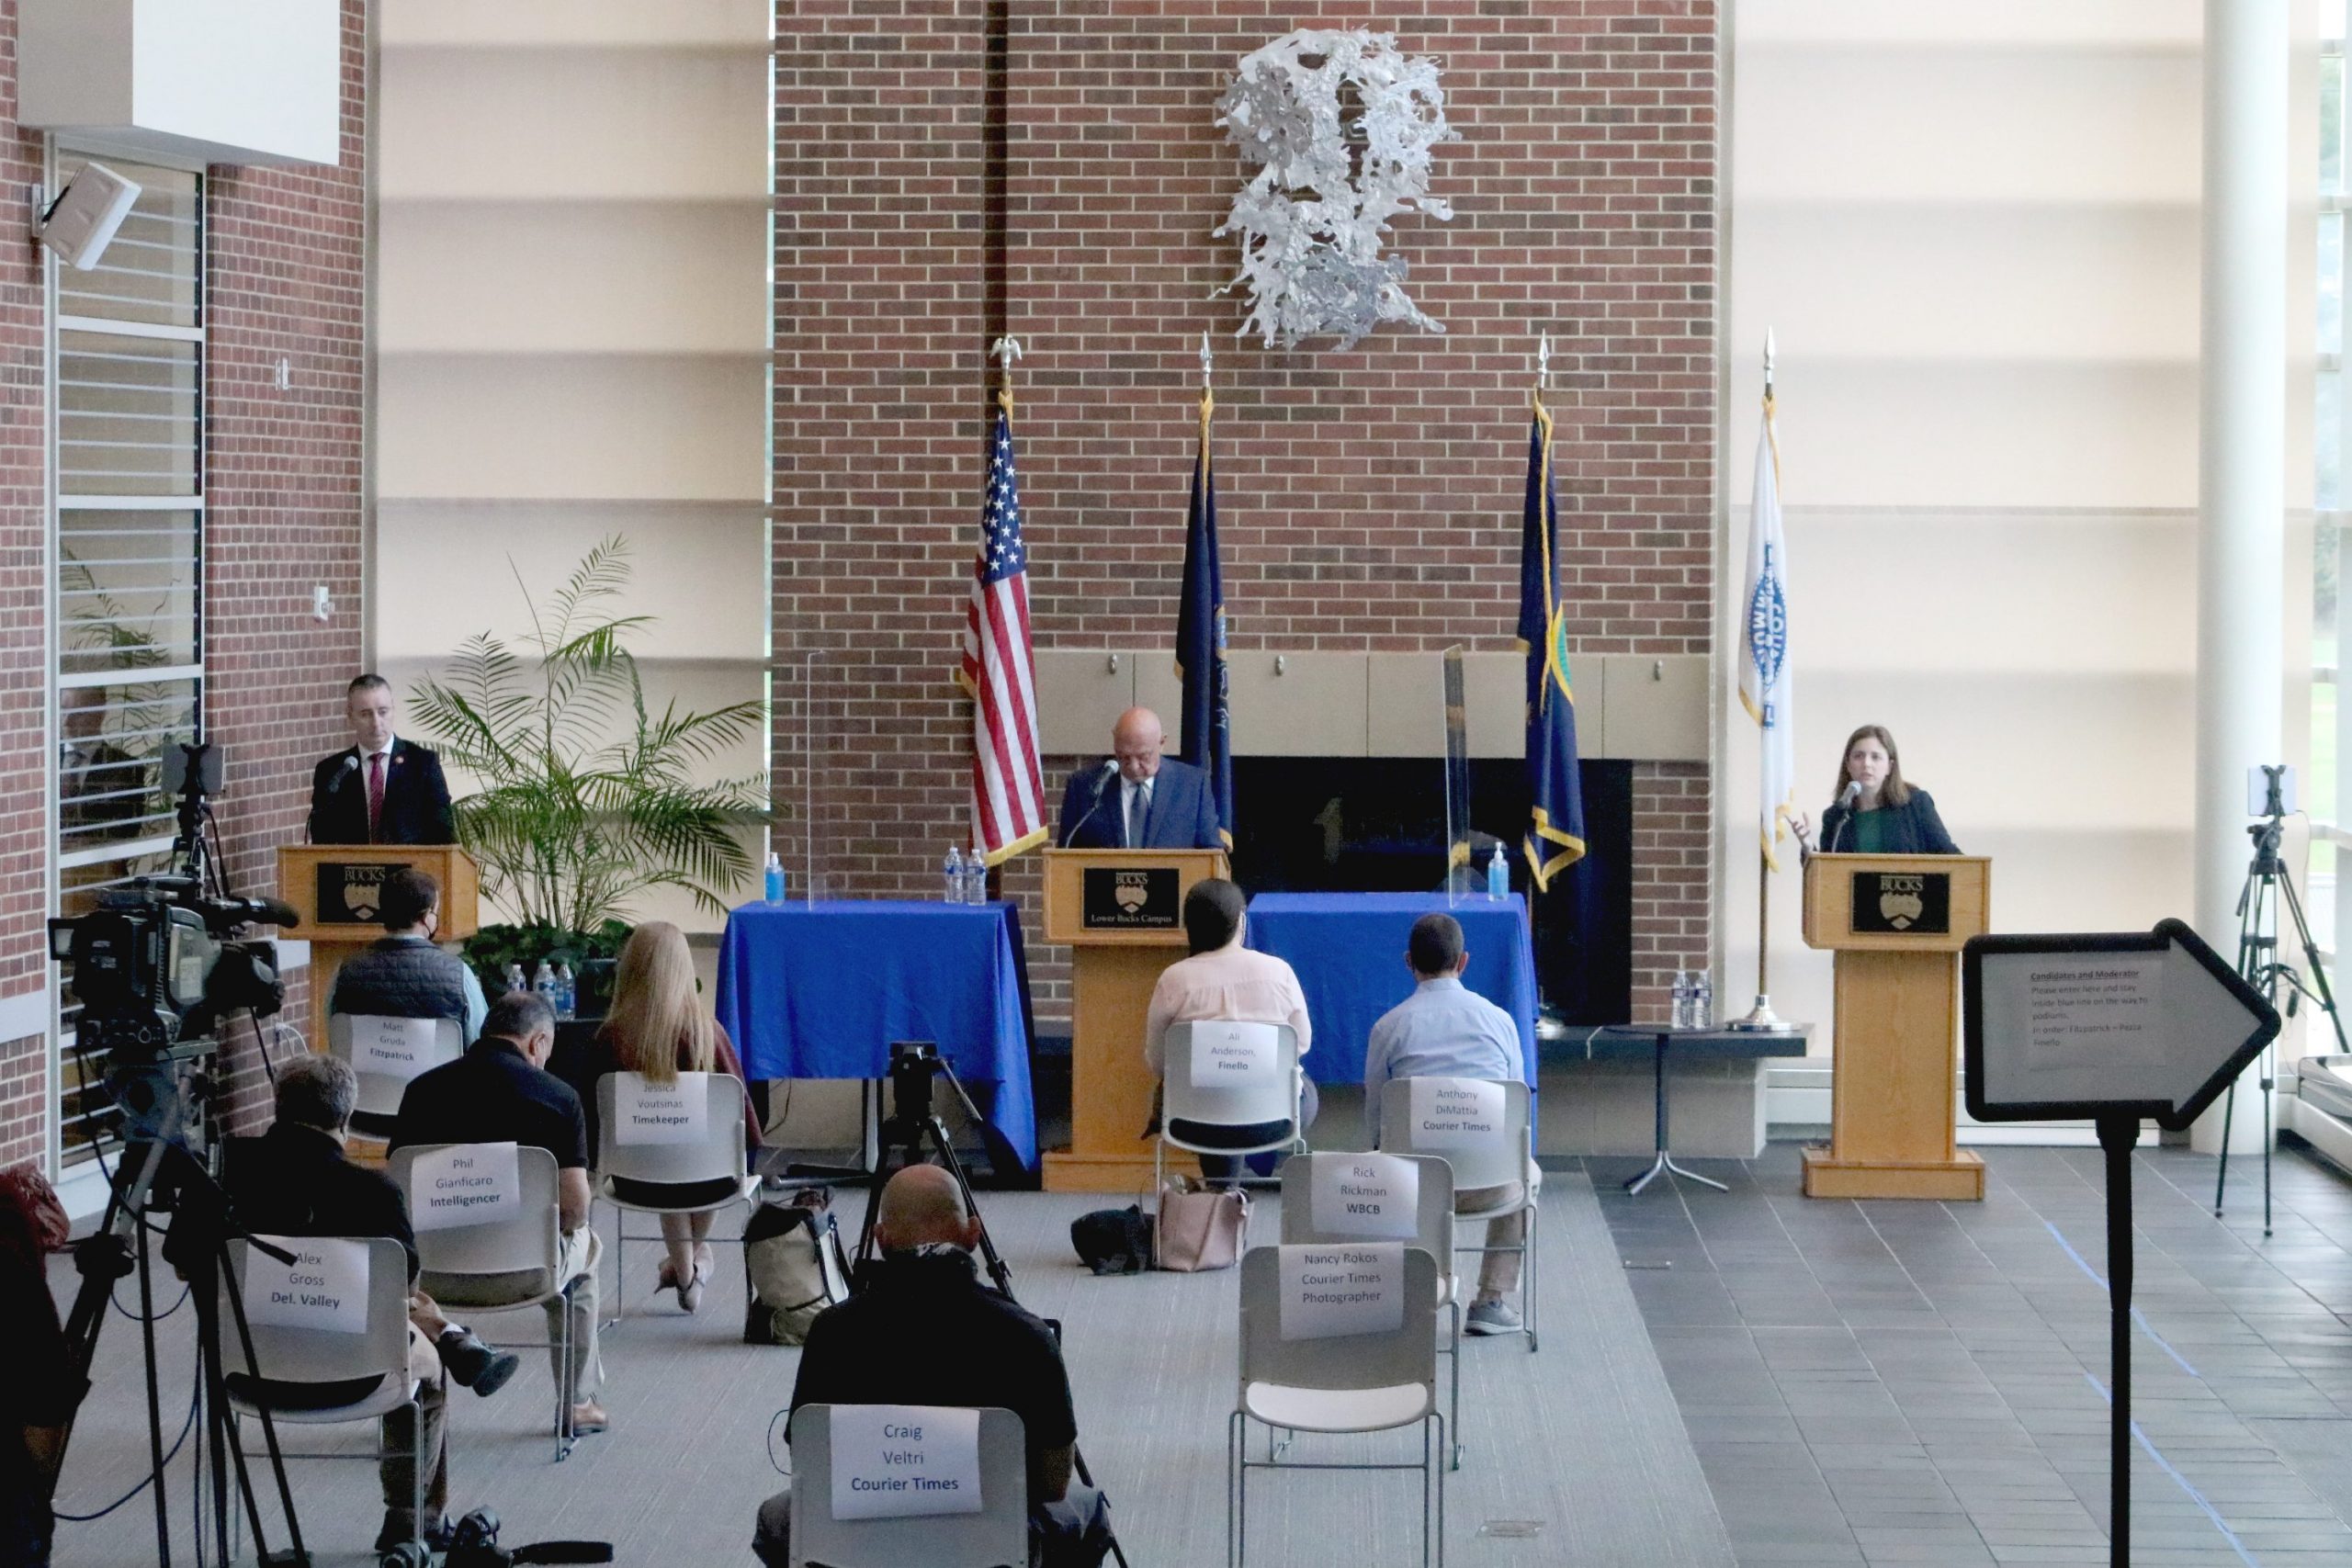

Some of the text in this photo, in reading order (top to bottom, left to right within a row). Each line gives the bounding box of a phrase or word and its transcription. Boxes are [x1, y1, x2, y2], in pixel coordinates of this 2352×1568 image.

[345, 867, 387, 882] BUCKS
[1115, 874, 1148, 885] BUCKS
[1880, 877, 1924, 892] BUCKS
[1091, 914, 1173, 924] Lower Bucks Campus
[2030, 969, 2140, 981] Candidates and Moderator
[2031, 987, 2057, 995] Please
[383, 1022, 403, 1032] Matt
[379, 1035, 406, 1046] Gruda
[1227, 1032, 1240, 1042] Ali
[369, 1047, 414, 1062] Fitzpatrick
[1211, 1046, 1256, 1057] Anderson,
[1218, 1061, 1249, 1070] Finello
[1436, 1089, 1478, 1100] Anthony
[637, 1100, 684, 1110] Voutsinas
[1436, 1105, 1478, 1115] DiMattia
[632, 1115, 689, 1126] Timekeeper
[1423, 1121, 1491, 1132] Courier Times
[453, 1158, 474, 1169] Phil
[1353, 1167, 1375, 1178] Rick
[435, 1177, 493, 1189] Gianficaro
[1340, 1185, 1387, 1197] Rickman
[430, 1194, 501, 1208] Intelligencer
[1346, 1203, 1381, 1214] WBCB
[296, 1252, 322, 1265] Alex
[1305, 1252, 1379, 1266] Nancy Rokos
[288, 1272, 325, 1286] Gross
[1302, 1272, 1382, 1285] Courier Times
[271, 1292, 340, 1310] Del. Valley
[1303, 1291, 1382, 1304] Photographer
[884, 1424, 923, 1440] Craig
[882, 1450, 924, 1465] Veltri
[851, 1477, 959, 1491] Courier Times
